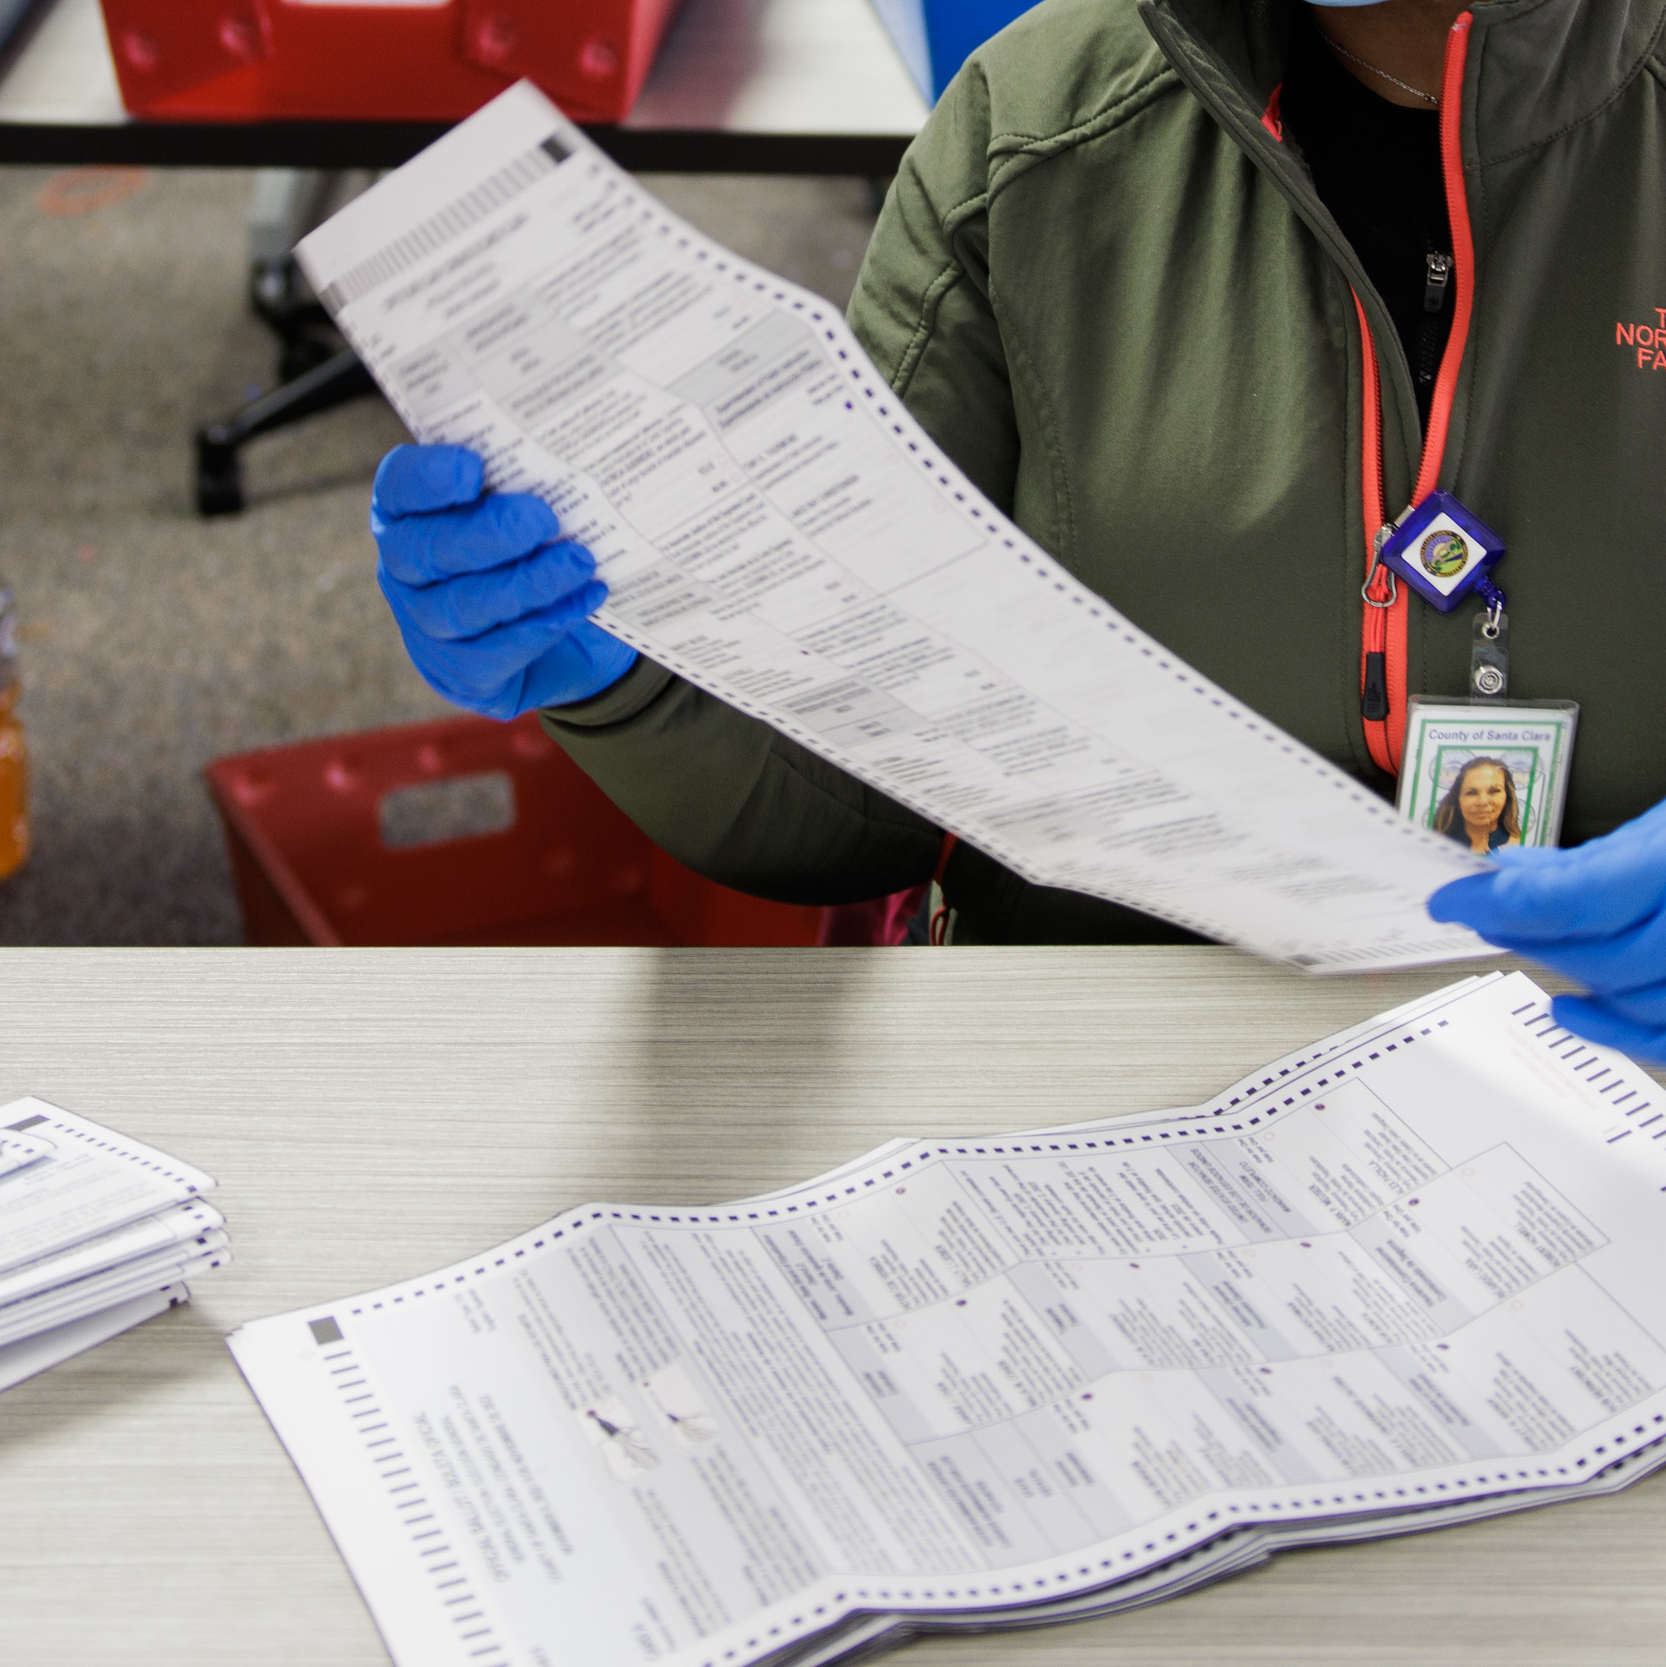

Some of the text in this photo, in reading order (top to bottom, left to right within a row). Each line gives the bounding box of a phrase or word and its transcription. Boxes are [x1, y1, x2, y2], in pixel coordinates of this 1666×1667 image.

[1428, 728, 1551, 743] County of Santa Clara
